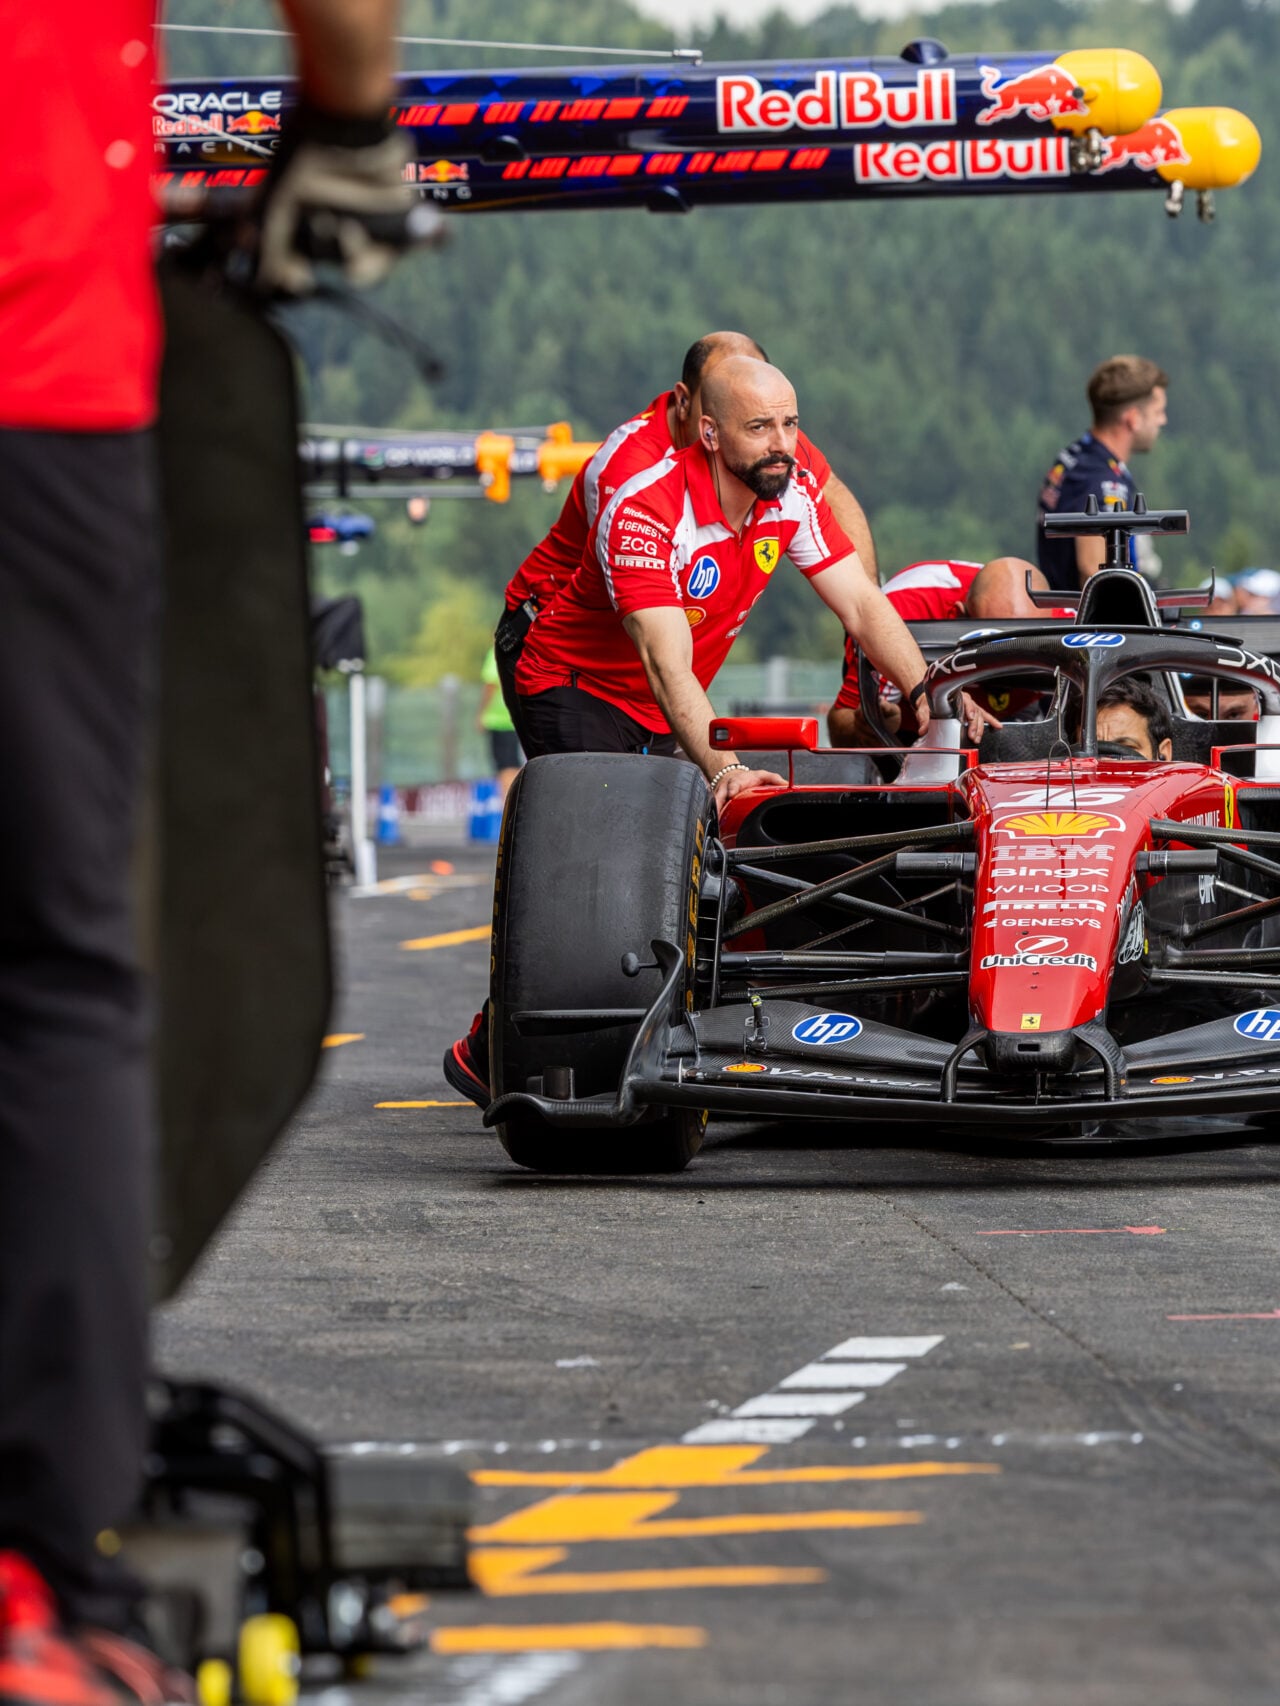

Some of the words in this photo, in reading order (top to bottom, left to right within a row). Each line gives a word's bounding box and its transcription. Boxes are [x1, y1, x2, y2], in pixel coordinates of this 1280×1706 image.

[152, 91, 283, 112] ORACLE
[721, 75, 832, 128] Red
[844, 72, 953, 125] Bull
[152, 113, 187, 137] Red
[859, 140, 958, 179] Red
[969, 138, 1066, 175] Bull
[622, 506, 671, 534] Bitdefender
[614, 554, 666, 571] PIRELLI
[690, 557, 716, 598] hp
[992, 787, 1136, 810] 16
[991, 844, 1116, 862] IBM
[991, 866, 1110, 878] BingX
[986, 884, 1110, 895] WHOOP
[983, 899, 1108, 913] PIRELLI
[1001, 918, 1102, 929] GENESYS
[981, 952, 1097, 972] UniCredit
[800, 1013, 856, 1045] hp
[769, 1067, 933, 1087] V-Power
